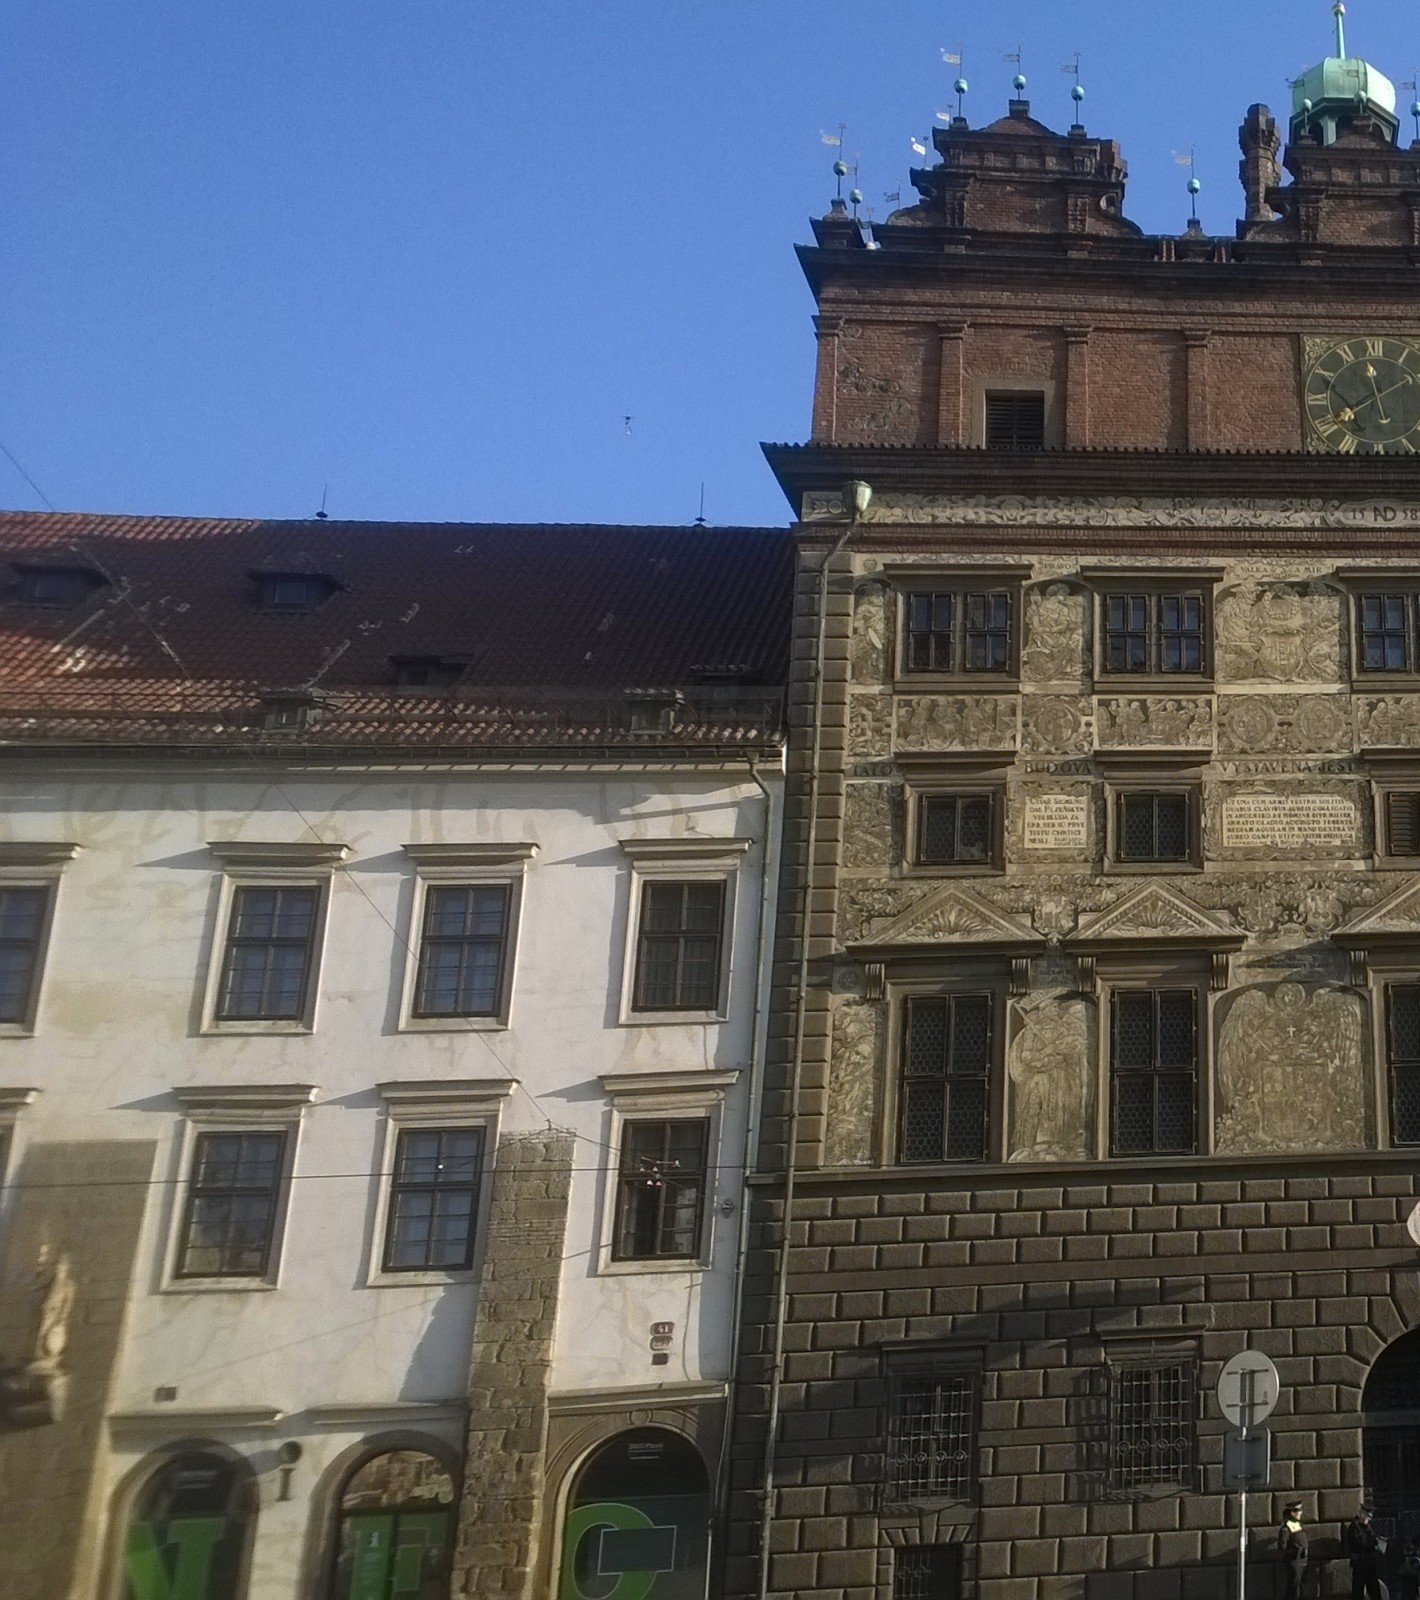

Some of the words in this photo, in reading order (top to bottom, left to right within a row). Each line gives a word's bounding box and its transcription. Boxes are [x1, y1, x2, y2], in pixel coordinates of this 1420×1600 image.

[1366, 340, 1383, 356] XII
[1240, 566, 1268, 574] VALKA
[1025, 761, 1092, 773] BUDOVA
[1220, 760, 1312, 773] VYSTAVENA
[1317, 760, 1357, 773] JEST
